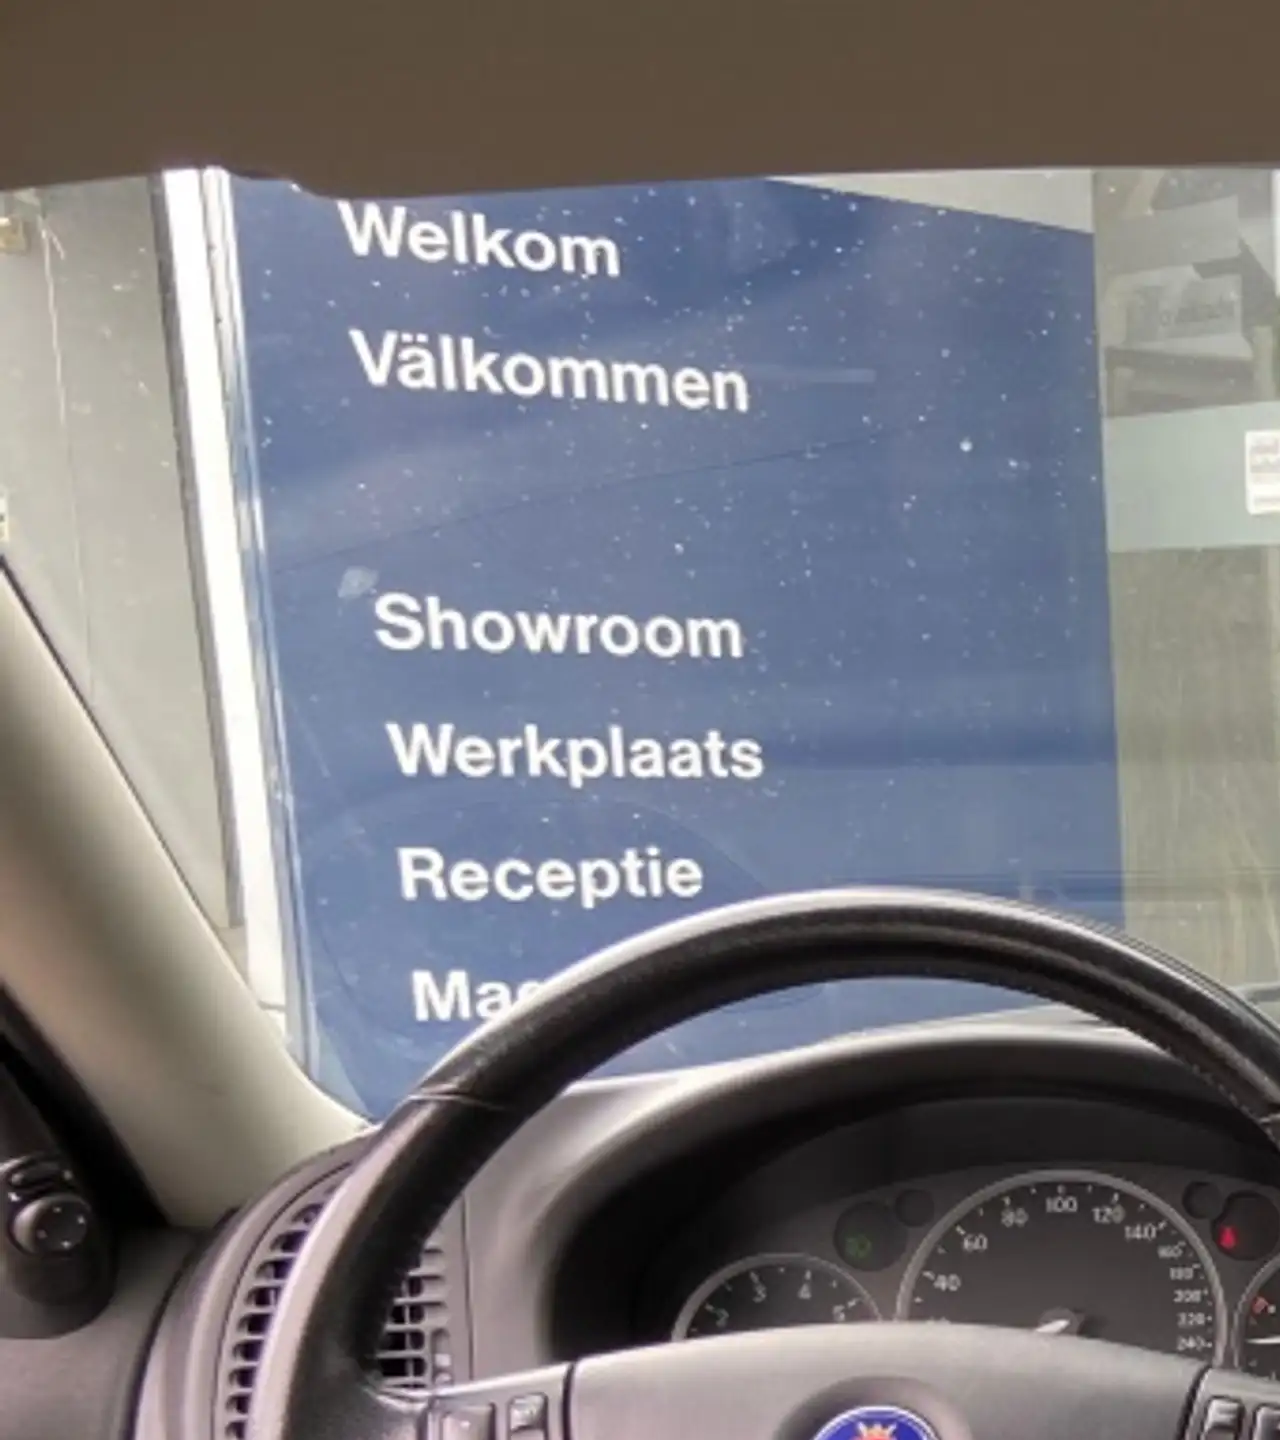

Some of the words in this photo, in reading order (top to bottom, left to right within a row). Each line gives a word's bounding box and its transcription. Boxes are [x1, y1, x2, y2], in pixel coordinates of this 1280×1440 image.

[339, 201, 622, 279] Welkom
[349, 328, 750, 413] Välkommen
[373, 592, 746, 661] Showroom
[385, 722, 765, 790] Werkplaats
[399, 845, 705, 910] Receptie
[1045, 1196, 1078, 1214] 100
[1092, 1206, 1126, 1224] 120
[1001, 1207, 1029, 1227] 80
[1124, 1223, 1157, 1241] 140
[962, 1233, 989, 1252] 60
[933, 1274, 961, 1292] 40
